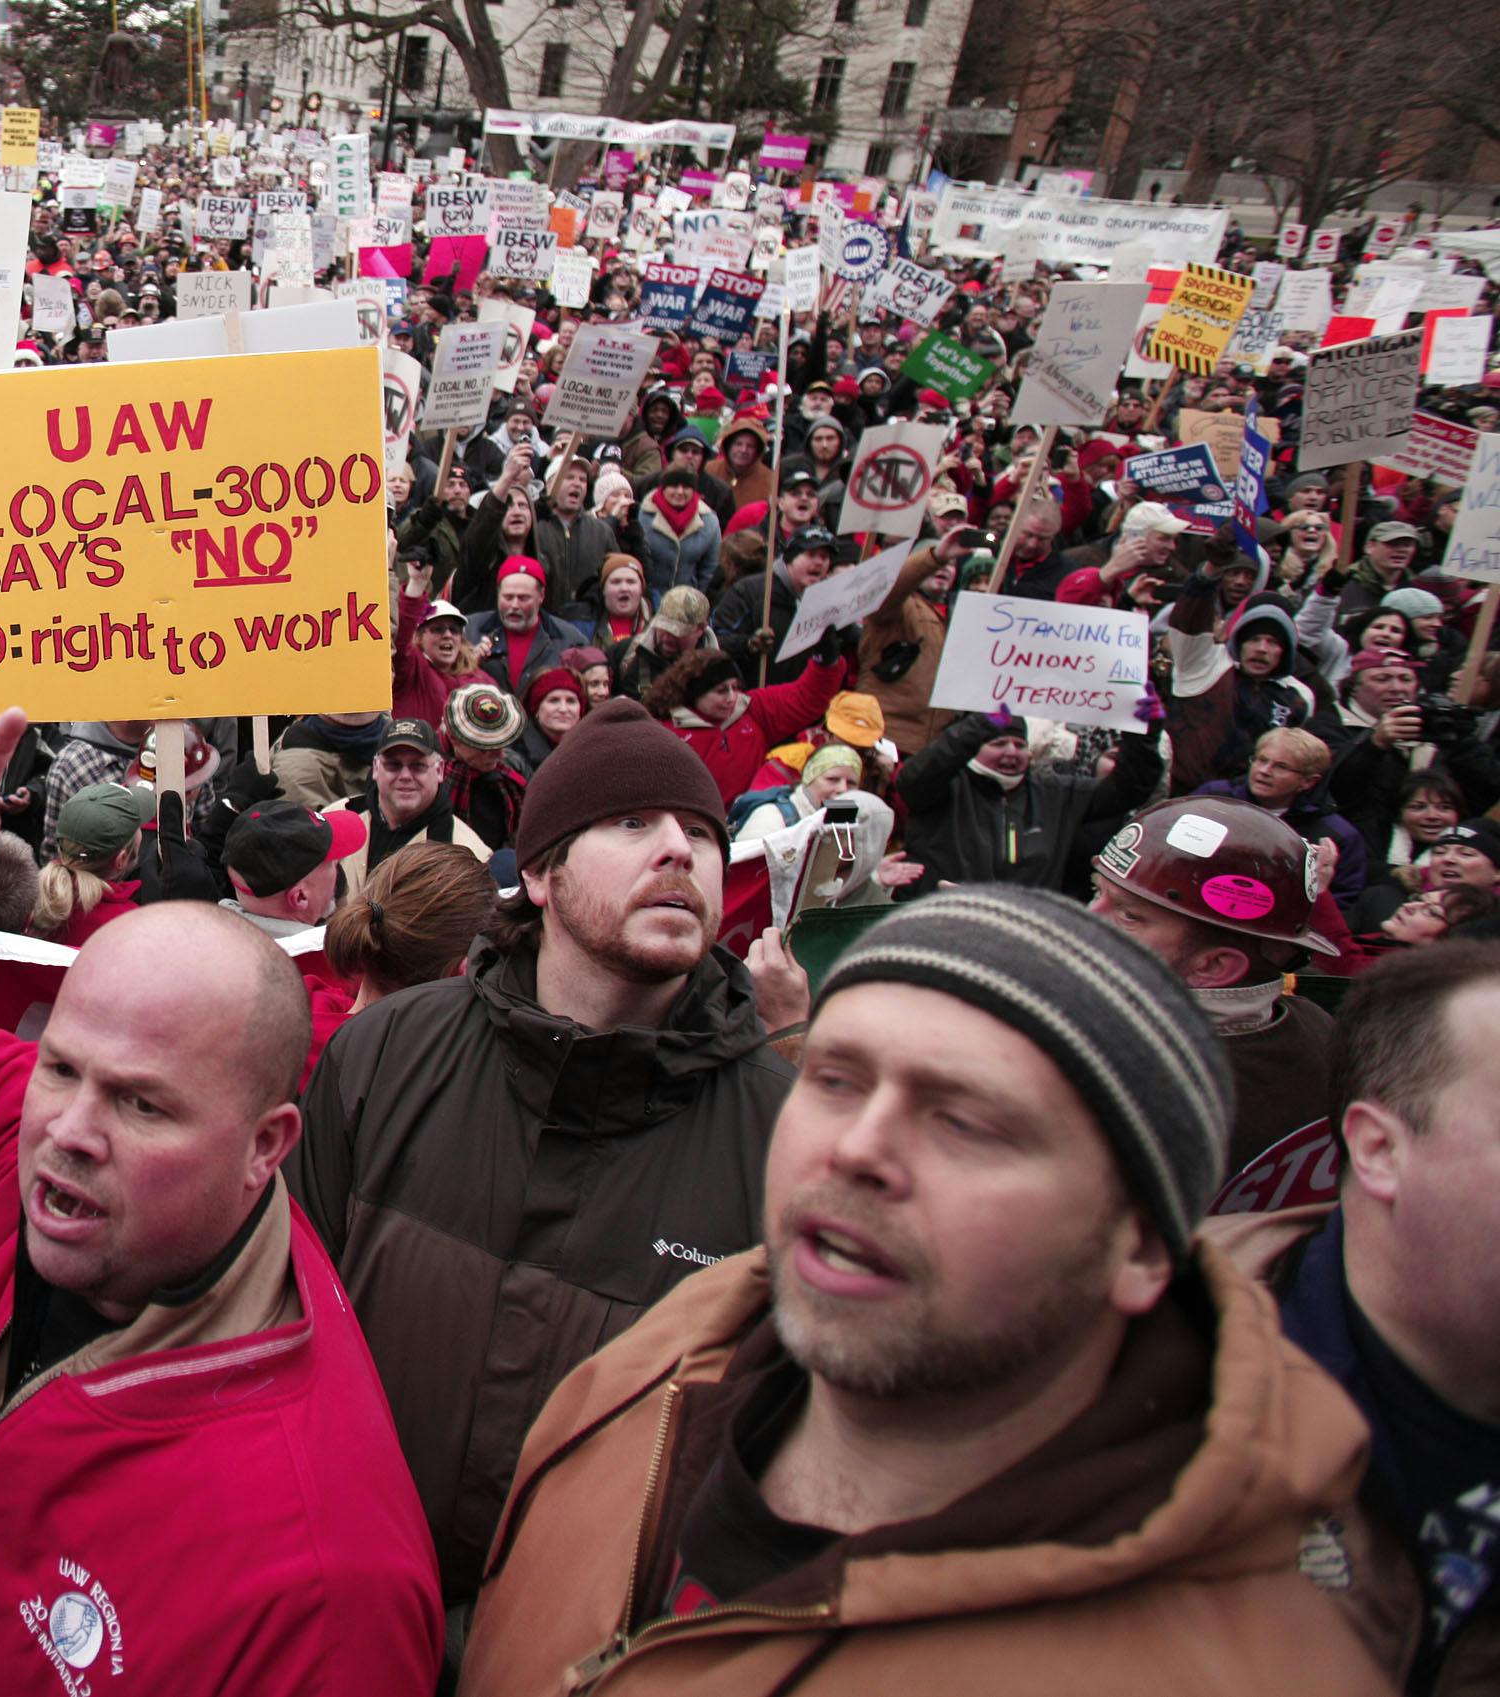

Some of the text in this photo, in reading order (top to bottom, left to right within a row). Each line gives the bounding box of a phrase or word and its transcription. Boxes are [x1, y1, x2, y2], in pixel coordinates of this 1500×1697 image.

[337, 142, 357, 216] AFSCME
[200, 198, 250, 214] IBEW
[260, 193, 304, 207] IBEW
[430, 187, 489, 208] IBEW
[683, 214, 721, 232] NO
[951, 200, 1211, 235] BRICKLAYERS AND ALLIED CRAFTWORKERS
[428, 226, 466, 236] LOCAL
[496, 231, 556, 249] IBEW
[845, 245, 871, 260] UAW
[194, 275, 233, 291] RICK
[648, 265, 698, 285] STOP
[711, 272, 765, 296] STOP
[891, 262, 950, 297] IBEW
[1184, 276, 1245, 302] SNYDER'S
[181, 293, 238, 309] SNYDER
[651, 293, 686, 309] WAR
[1178, 290, 1233, 314] AGENDA
[708, 304, 747, 323] WAR
[460, 332, 491, 343] R.T.W.
[691, 319, 741, 341] WORKERS
[1187, 324, 1203, 338] TO
[598, 338, 635, 352] R.T.W.
[1157, 330, 1219, 359] DISASTER
[1311, 334, 1422, 367] MICHIGAN
[924, 351, 973, 386] Together
[433, 381, 462, 394] LOCAL
[464, 378, 478, 390] NO.
[561, 379, 631, 401] LOCAL NO. 17
[1307, 370, 1415, 410] OFFICERS
[560, 401, 617, 416] BROTHERHOOD
[563, 392, 619, 408] INTERNATIONAL
[1306, 401, 1382, 430] PROTECT
[47, 398, 213, 463] UAW
[1130, 456, 1159, 471] FIGHT
[1134, 463, 1177, 481] ATTACK
[857, 456, 924, 503] RTW
[1142, 467, 1208, 487] AMERICAN
[1155, 479, 1201, 494] DREAM
[162, 628, 226, 674] to
[234, 592, 383, 652] work
[987, 601, 1111, 646] STANDING
[989, 639, 1096, 675] UNIONS
[991, 675, 1115, 712] UTERUSES
[59, 1556, 124, 1652] UAW REGION
[18, 1600, 42, 1635] GOLF
